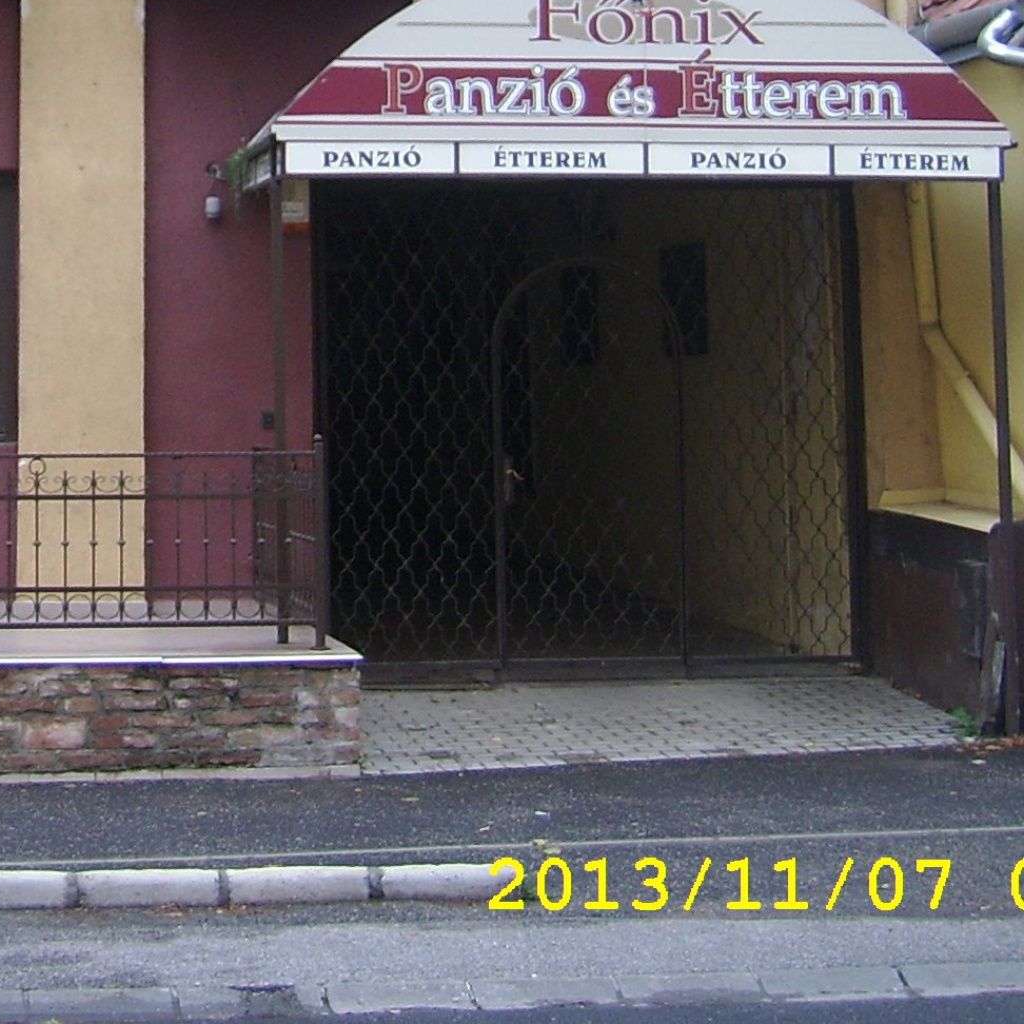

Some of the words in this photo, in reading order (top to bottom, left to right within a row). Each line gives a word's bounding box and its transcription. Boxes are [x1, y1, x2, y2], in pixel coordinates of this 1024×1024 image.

[381, 63, 586, 117] Panzió
[605, 75, 655, 117] és
[677, 49, 907, 121] Étterem
[322, 147, 422, 168] PANZIÓ
[493, 147, 608, 170] ÉTTEREM
[690, 149, 788, 171] PANZIÓ
[859, 150, 971, 172] ÉTTEREM
